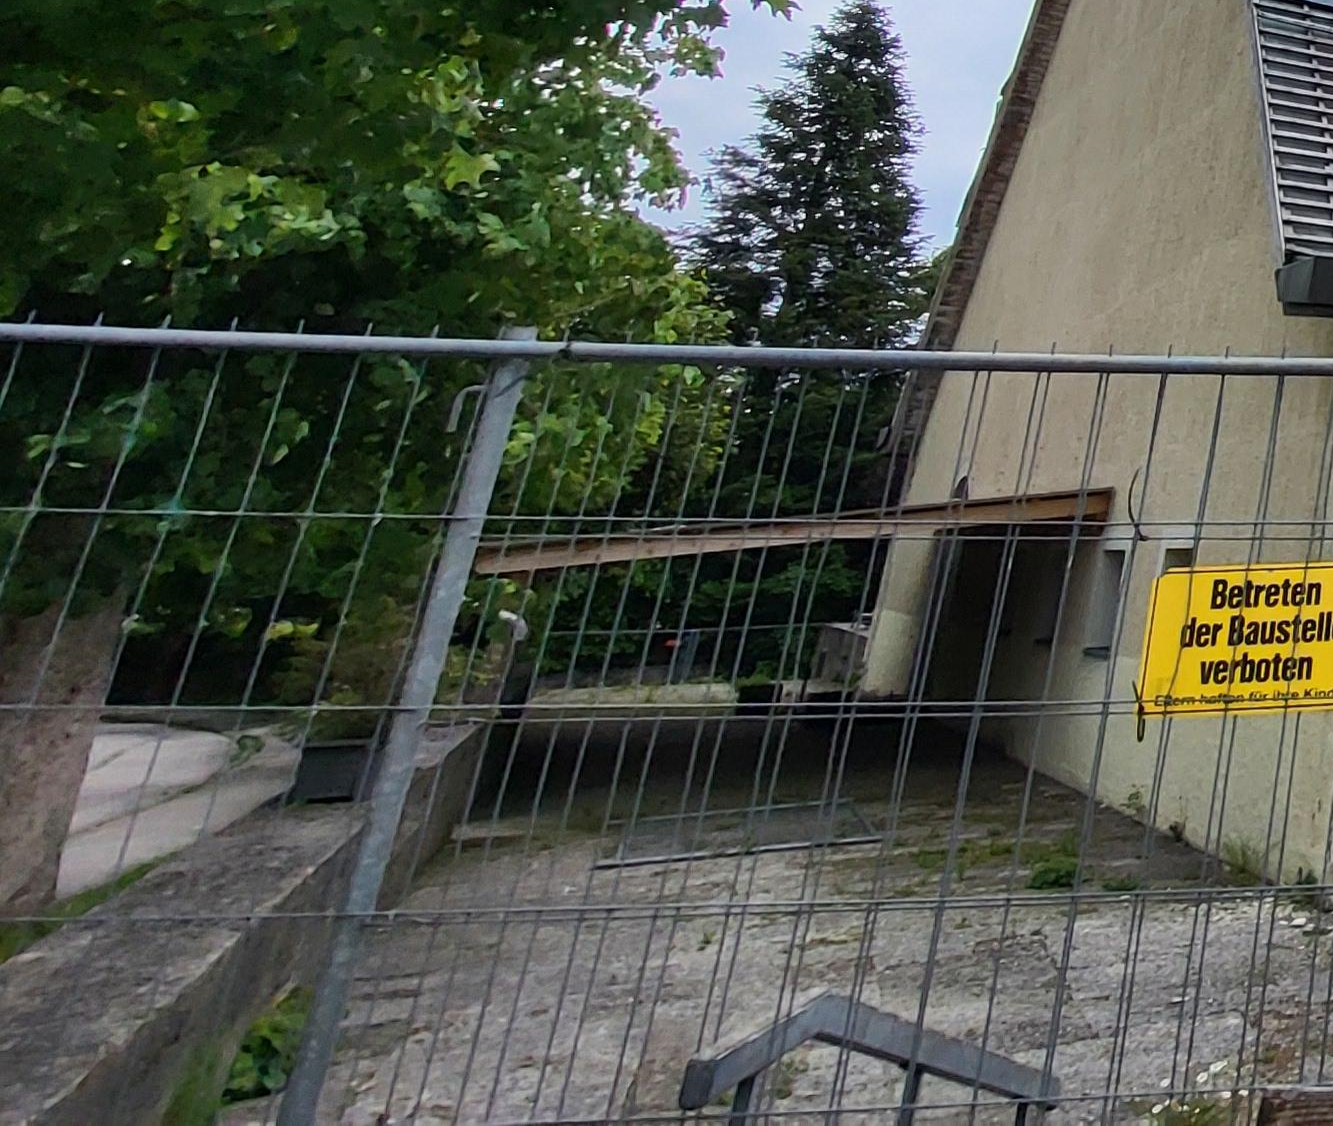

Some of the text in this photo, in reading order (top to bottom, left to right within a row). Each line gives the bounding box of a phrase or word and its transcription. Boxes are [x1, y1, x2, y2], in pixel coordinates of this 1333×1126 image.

[1210, 578, 1321, 609] Betreten
[1181, 617, 1223, 648] der
[1199, 652, 1313, 685] verboten
